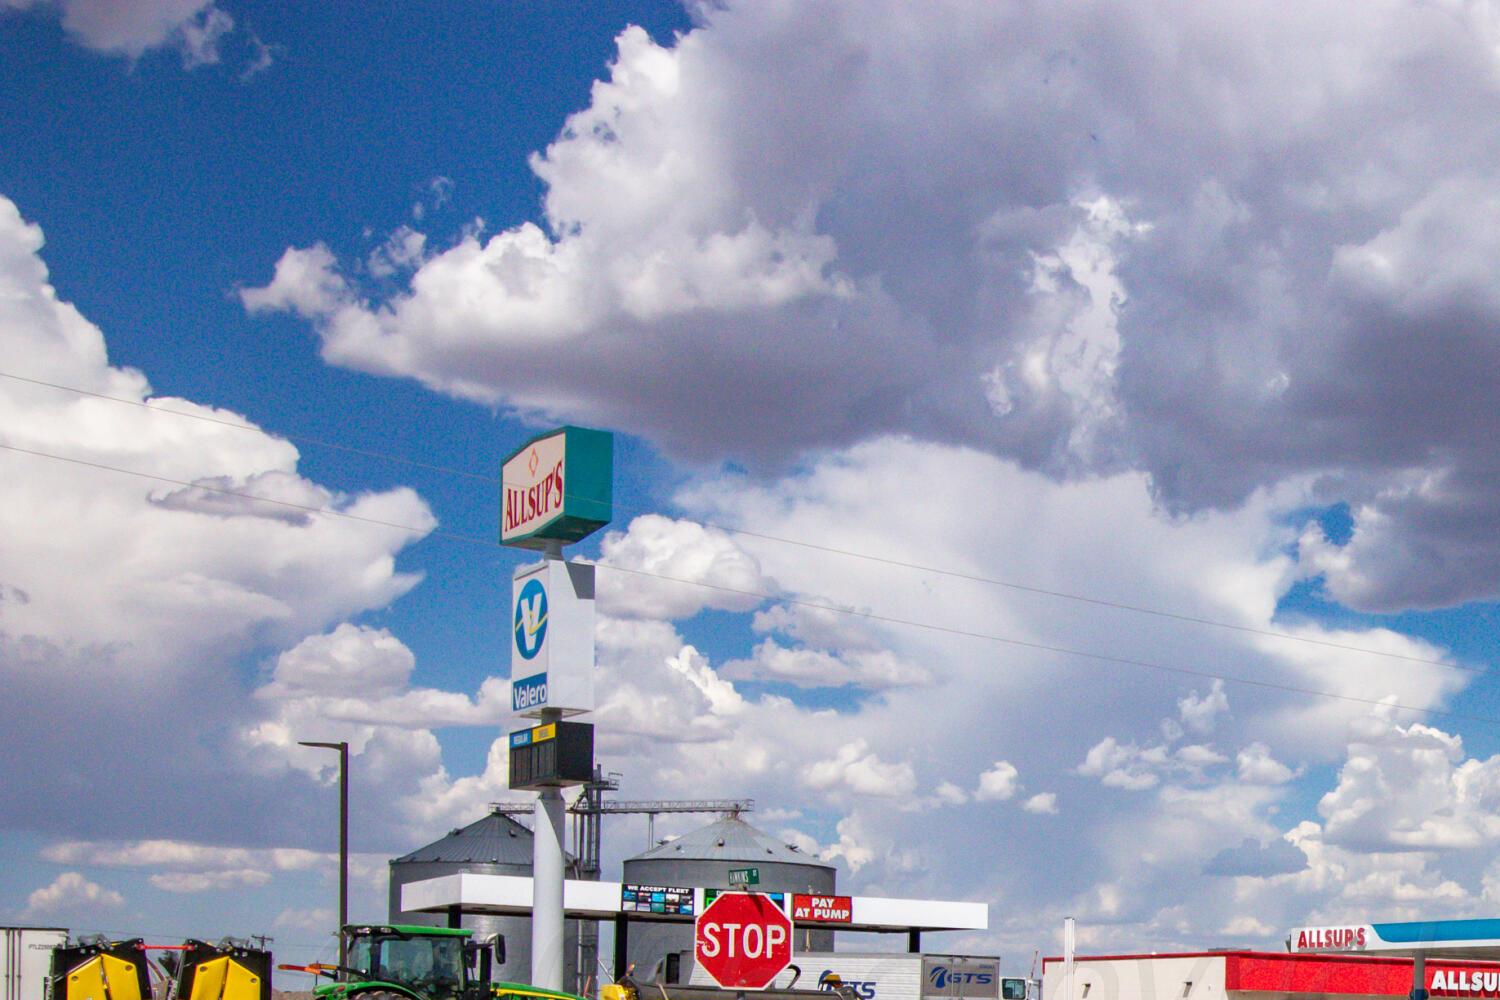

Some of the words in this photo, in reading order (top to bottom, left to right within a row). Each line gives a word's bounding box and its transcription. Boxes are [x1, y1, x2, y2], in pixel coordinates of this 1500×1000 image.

[504, 459, 564, 533] ALLSUP'S
[513, 681, 548, 711] Valero
[795, 907, 813, 918] AT
[813, 908, 850, 920] PUMP
[811, 897, 835, 908] PAY
[701, 922, 786, 959] STOP
[1297, 927, 1366, 949] ALLSUP'S
[946, 972, 993, 985] GTS
